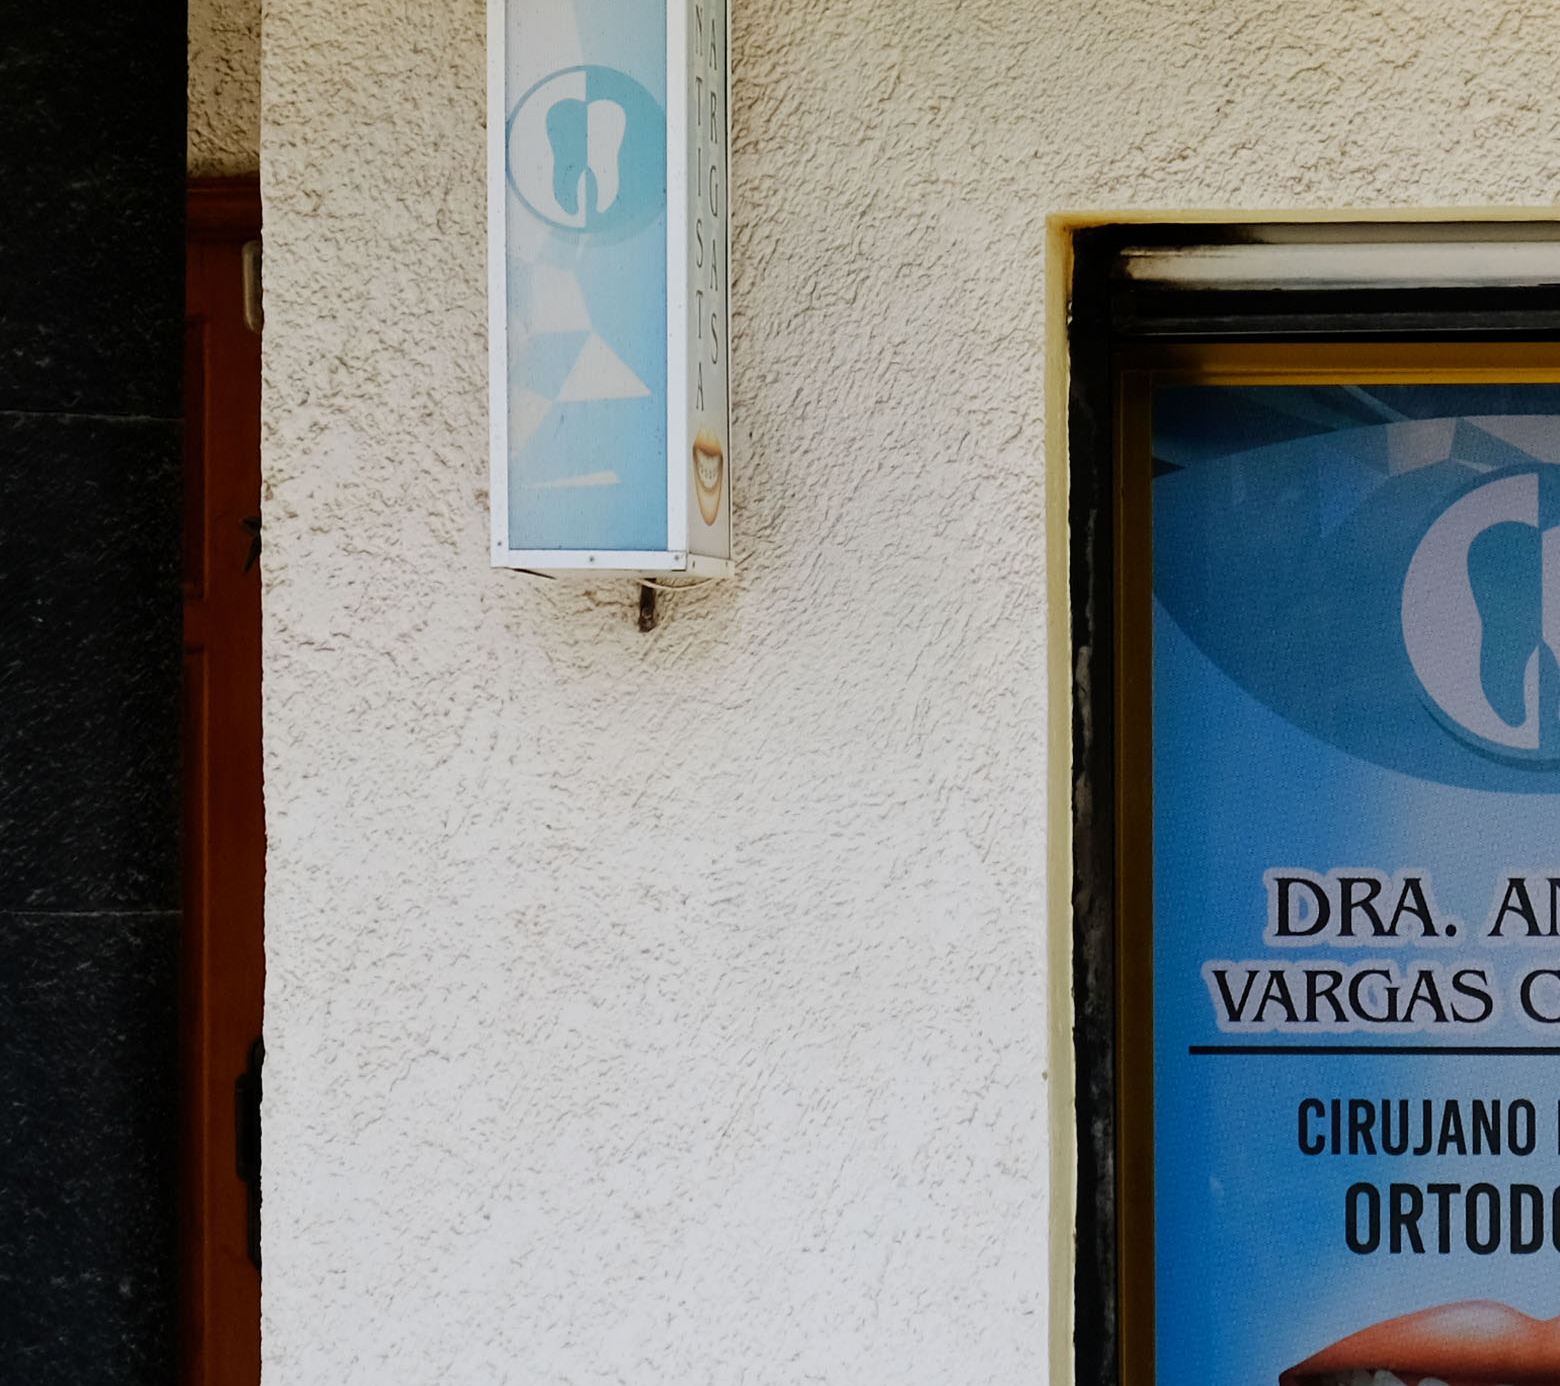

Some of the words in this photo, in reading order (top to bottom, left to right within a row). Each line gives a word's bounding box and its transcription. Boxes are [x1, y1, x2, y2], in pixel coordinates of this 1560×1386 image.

[1274, 877, 1457, 937] DRA.
[1211, 968, 1494, 1025] VARGAS
[1297, 1097, 1536, 1157] CIRUJANO
